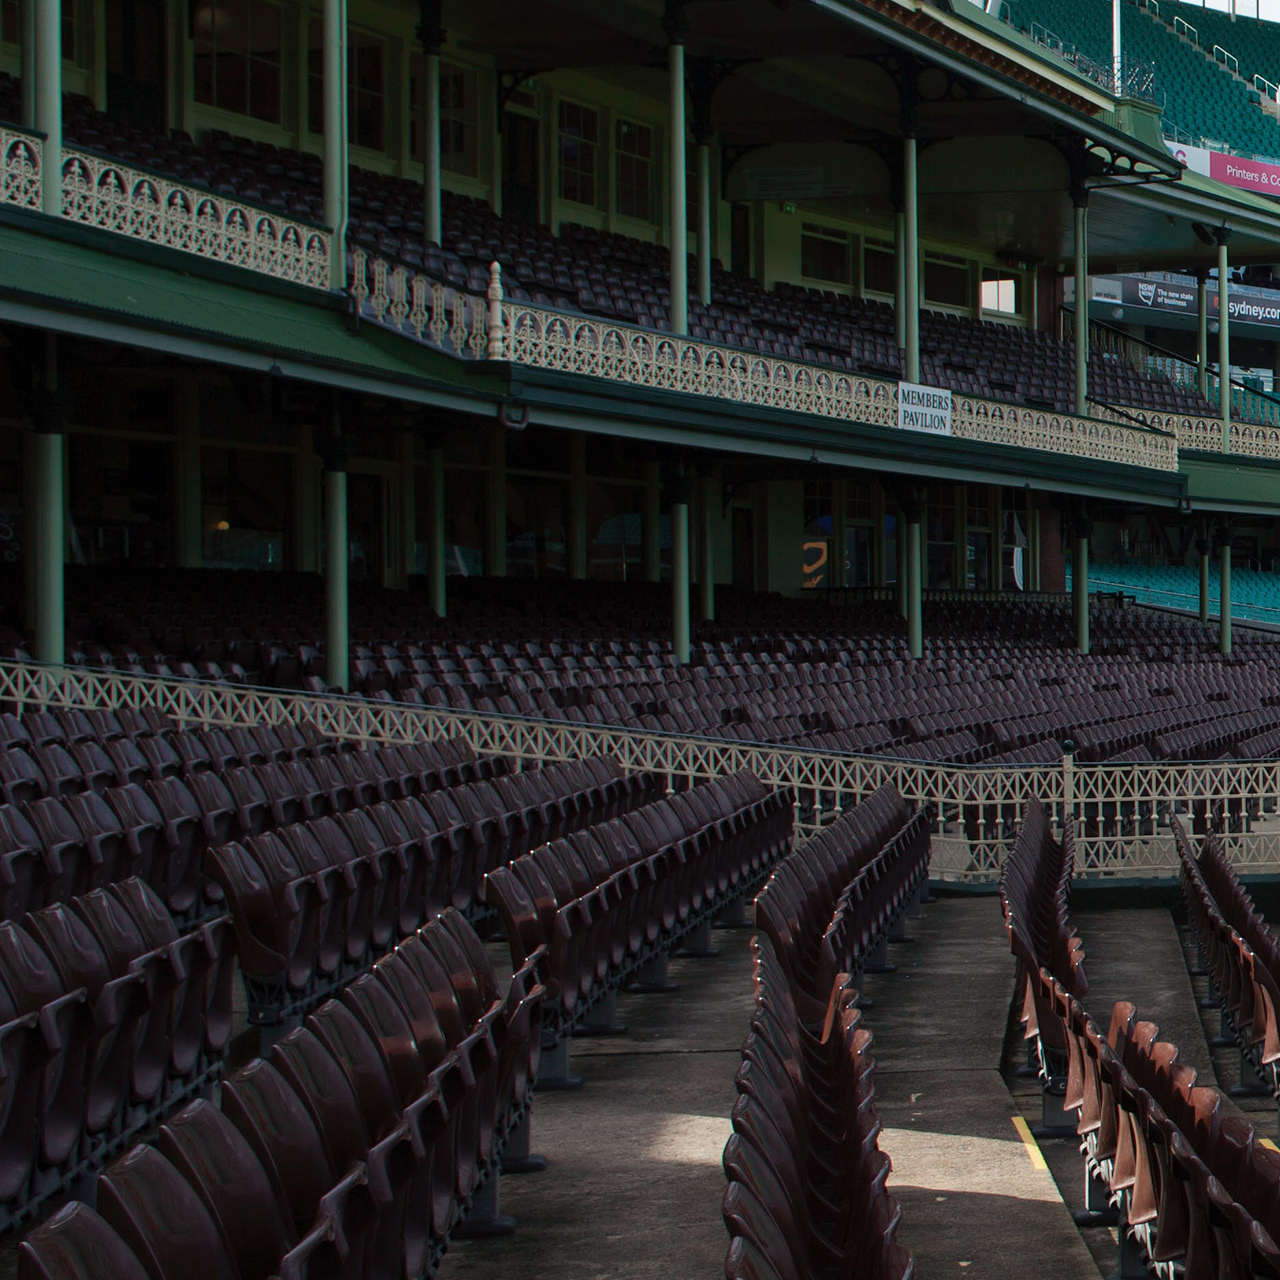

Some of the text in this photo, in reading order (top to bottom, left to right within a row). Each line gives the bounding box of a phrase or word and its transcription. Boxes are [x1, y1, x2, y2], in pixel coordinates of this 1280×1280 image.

[1226, 165, 1260, 183] Printers
[1260, 173, 1269, 184] &
[1157, 288, 1169, 297] The
[1165, 297, 1187, 307] business
[901, 388, 950, 411] MEMBERS
[903, 411, 947, 430] PAVILION
